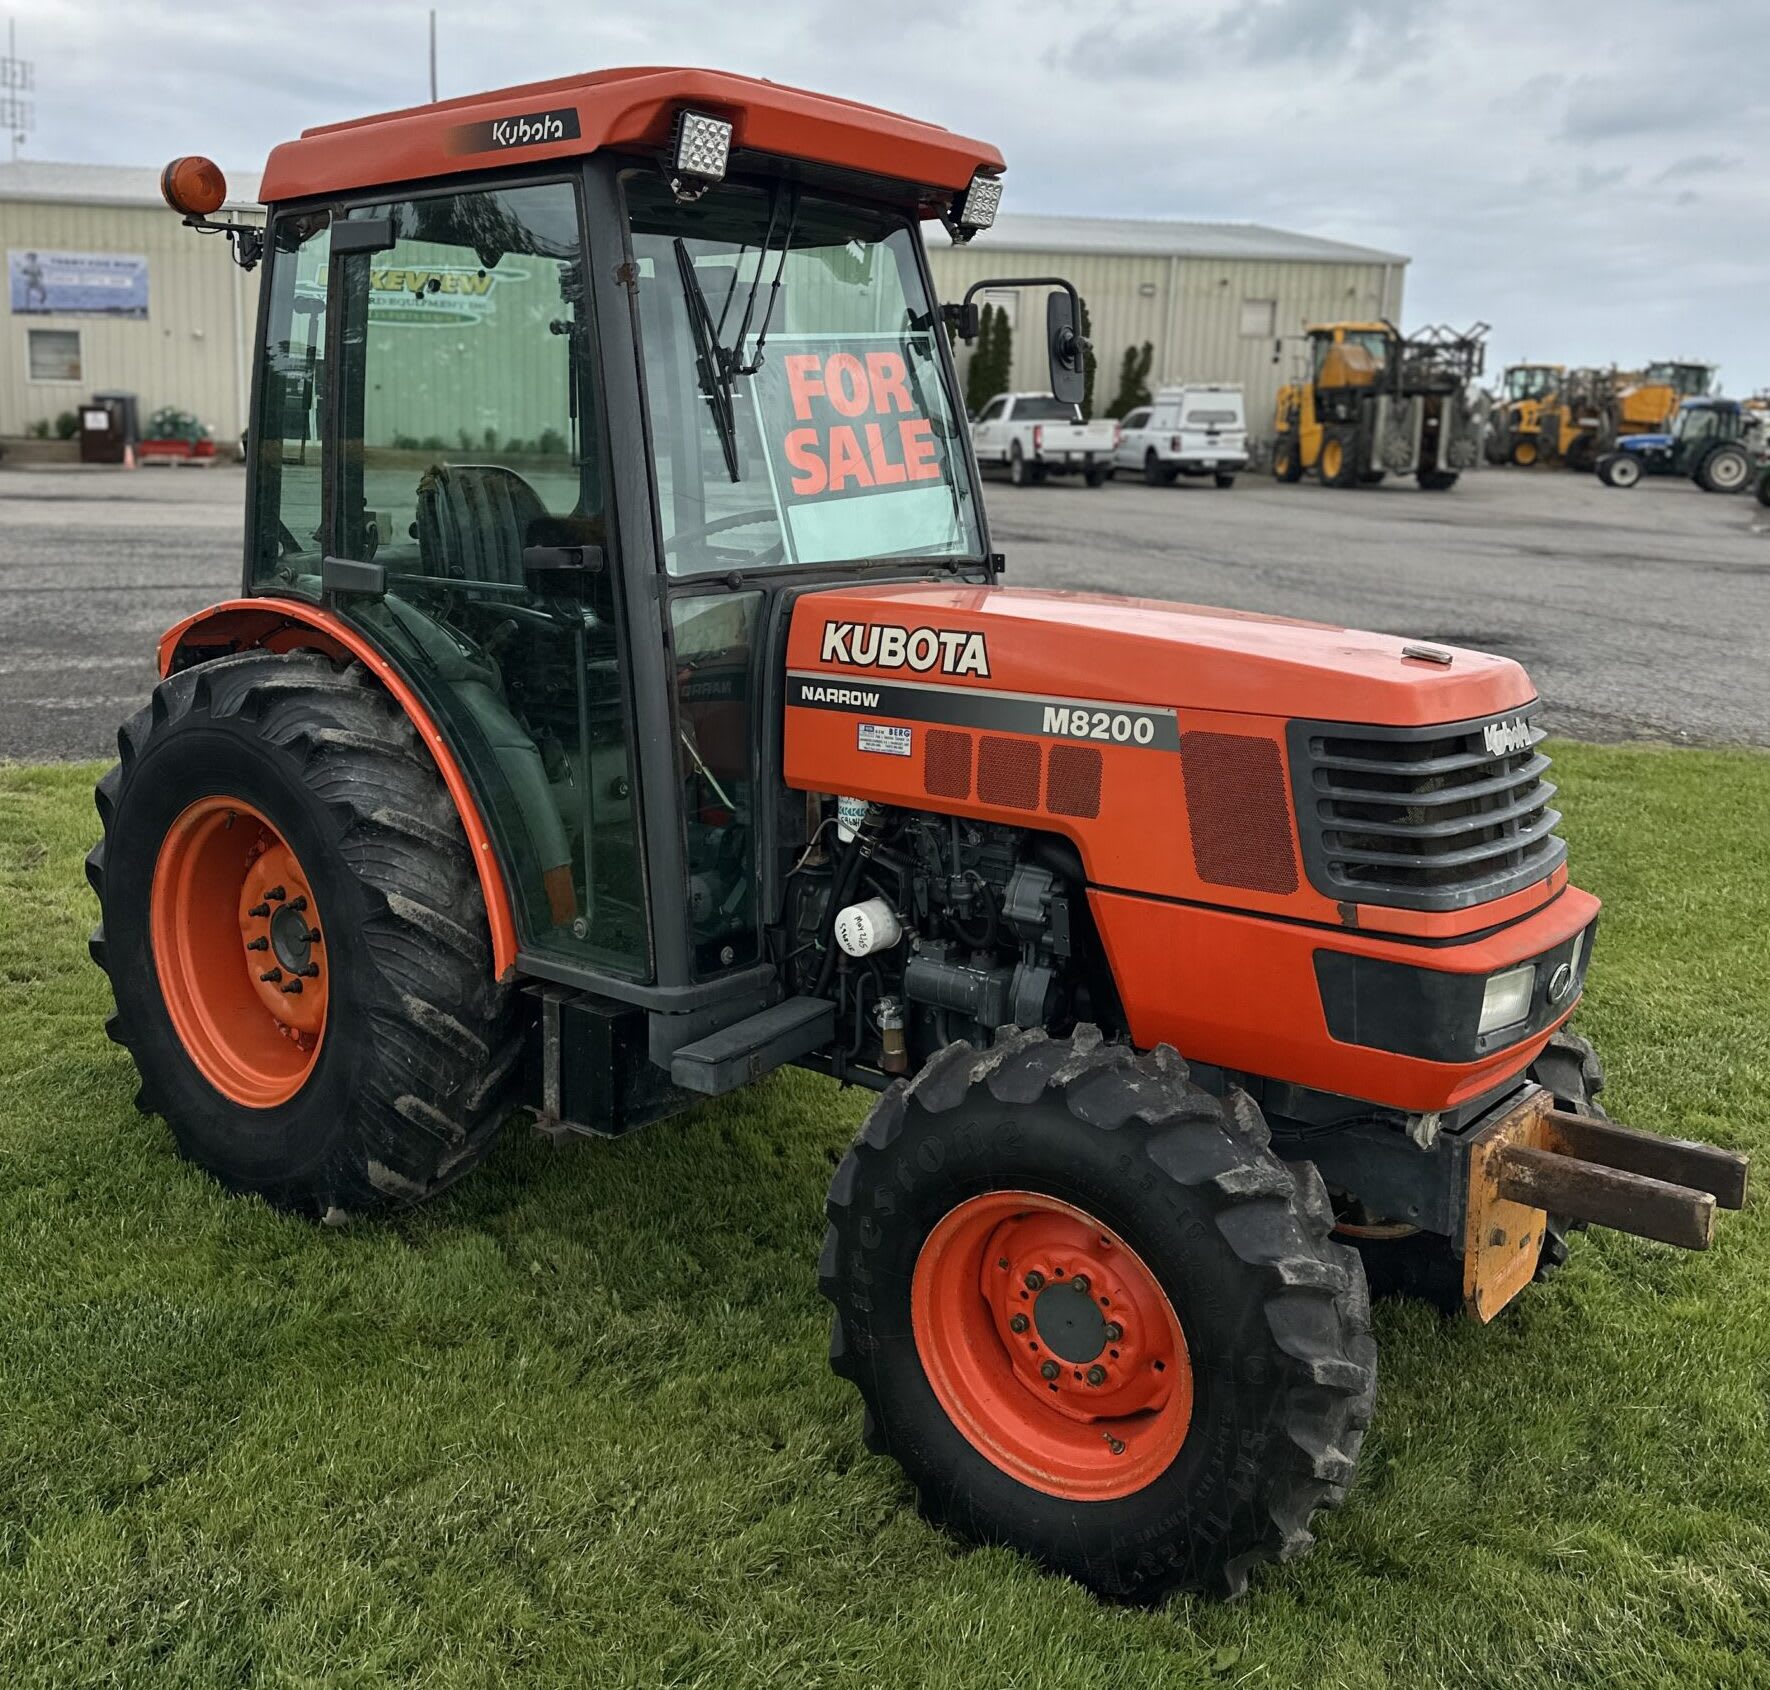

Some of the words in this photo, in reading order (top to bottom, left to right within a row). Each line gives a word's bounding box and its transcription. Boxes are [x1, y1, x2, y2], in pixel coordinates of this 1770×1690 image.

[492, 115, 563, 145] Kubota
[784, 352, 913, 420] FOR
[784, 418, 940, 495] SALE
[820, 620, 991, 678] KUBOTA
[801, 685, 879, 708] NARROW
[889, 728, 910, 737] BERG
[1042, 706, 1155, 744] M8200
[1482, 716, 1532, 756] Kubota
